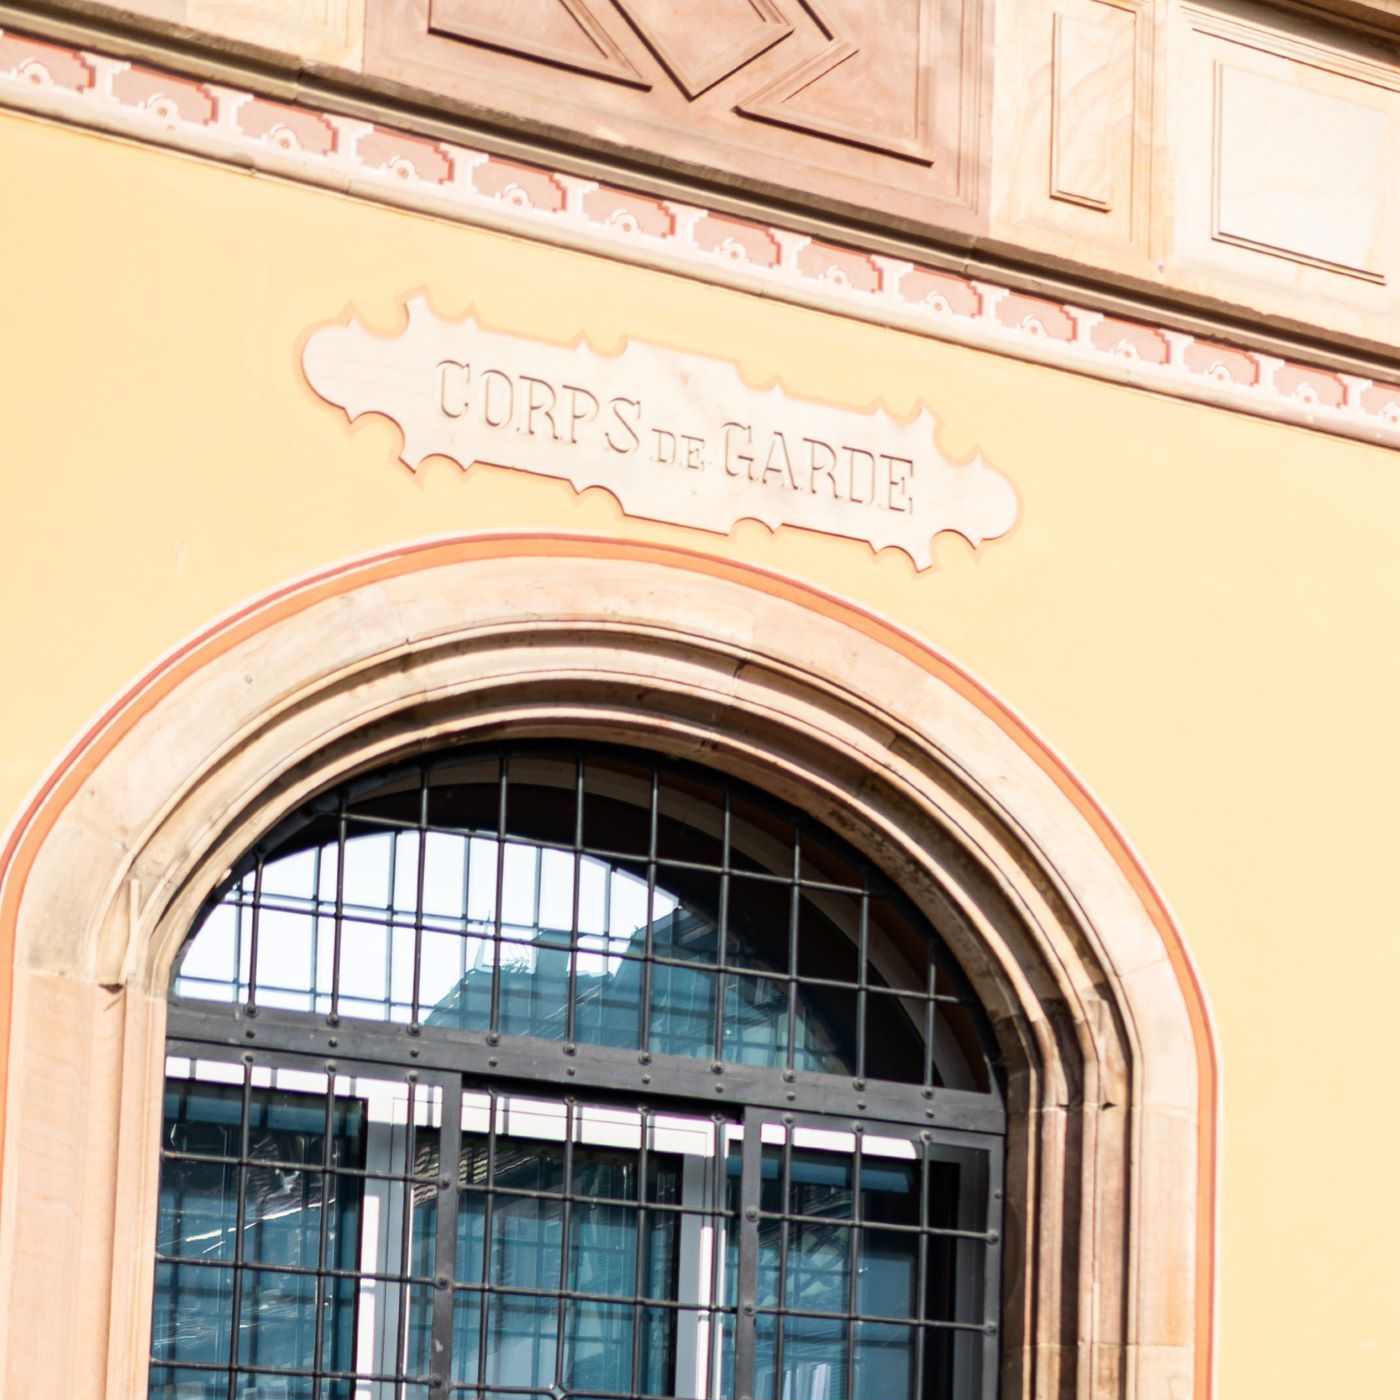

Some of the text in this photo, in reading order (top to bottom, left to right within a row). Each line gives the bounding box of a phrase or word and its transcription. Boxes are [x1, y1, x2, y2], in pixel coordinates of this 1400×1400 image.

[435, 359, 914, 514] CORPS DE GARDE
